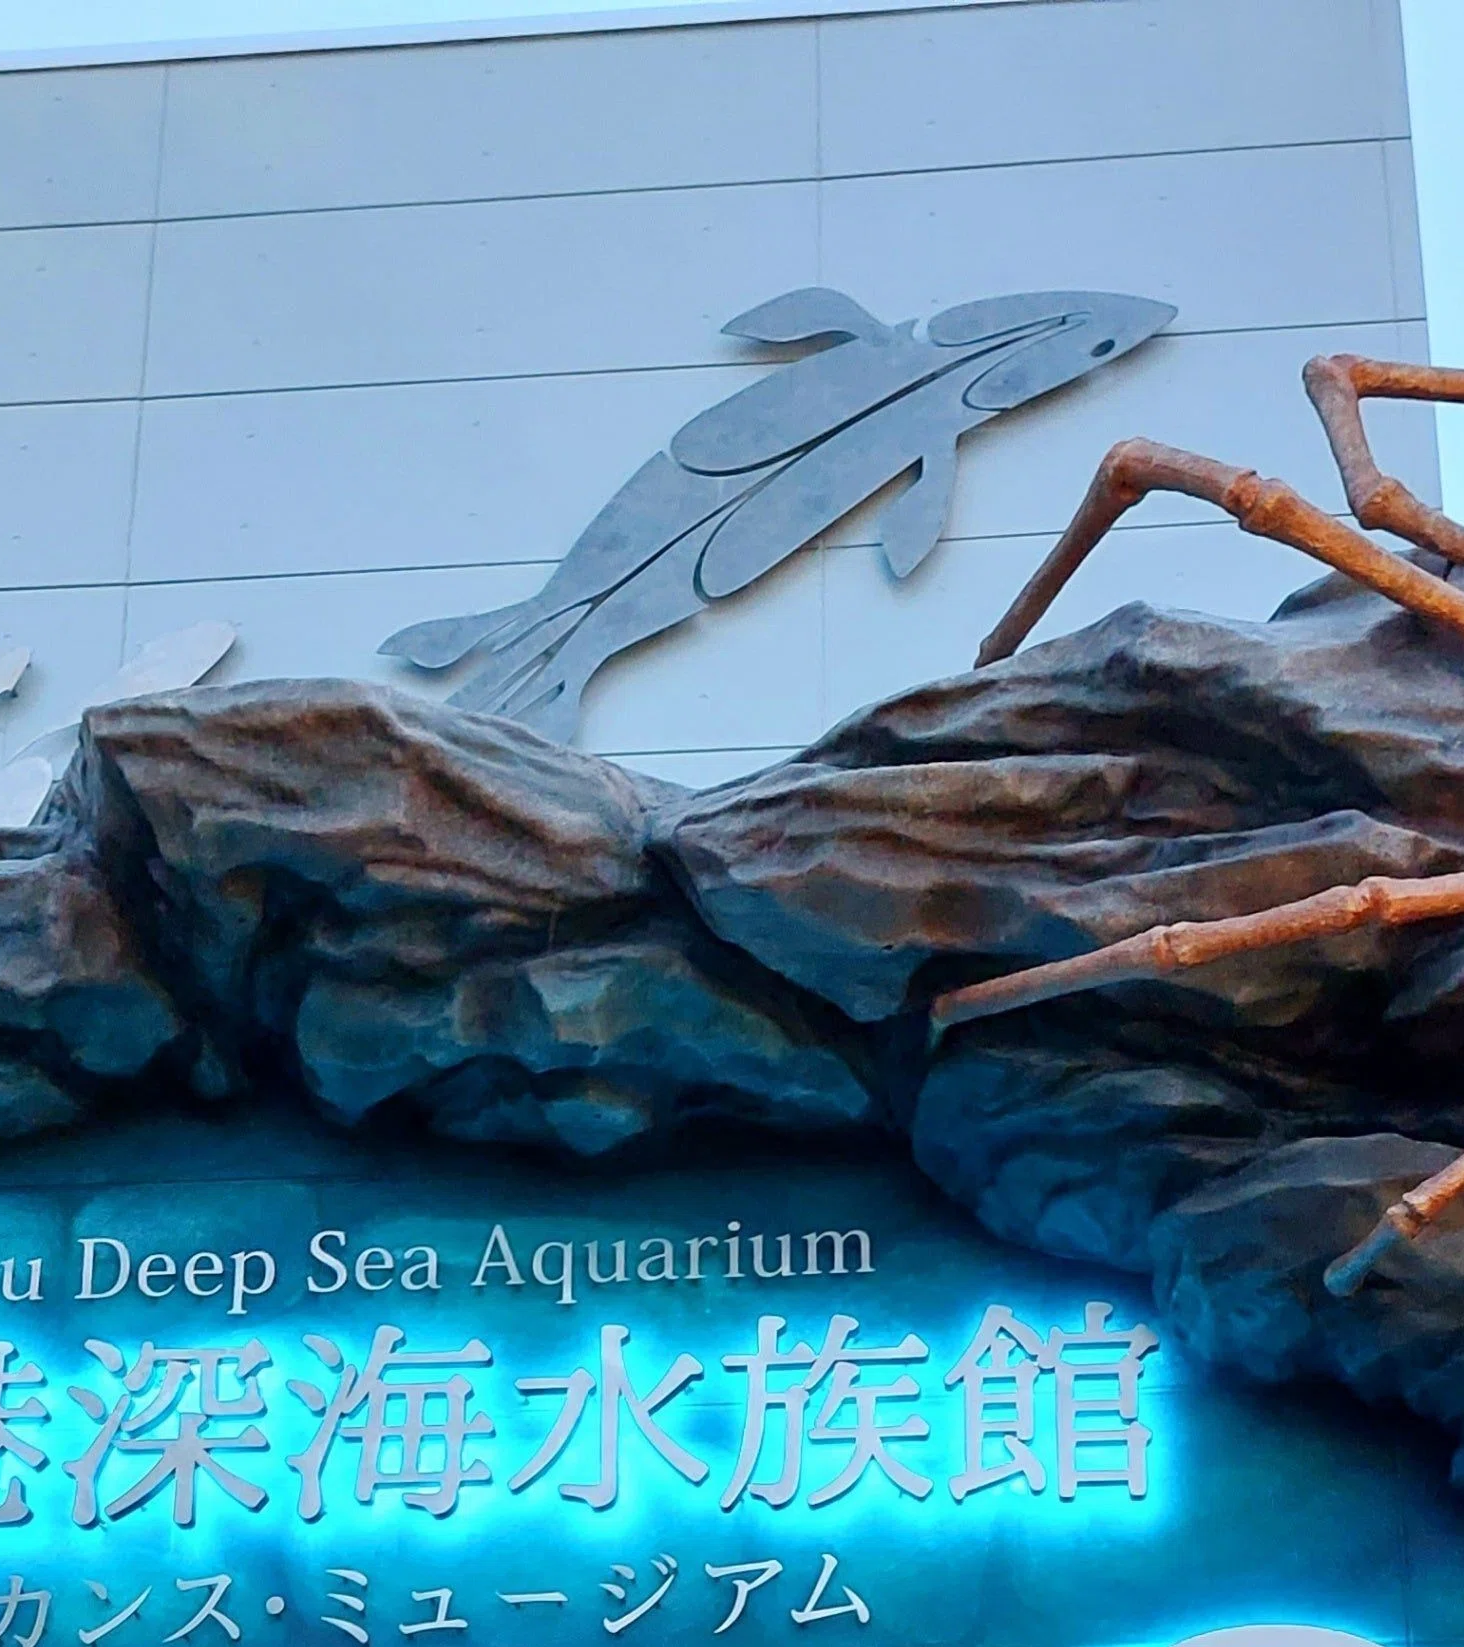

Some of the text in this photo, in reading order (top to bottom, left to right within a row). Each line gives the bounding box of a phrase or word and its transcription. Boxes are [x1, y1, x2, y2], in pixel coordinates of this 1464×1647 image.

[73, 1237, 276, 1315] Deep
[305, 1230, 441, 1294] Sea
[470, 1221, 876, 1305] Aquarium
